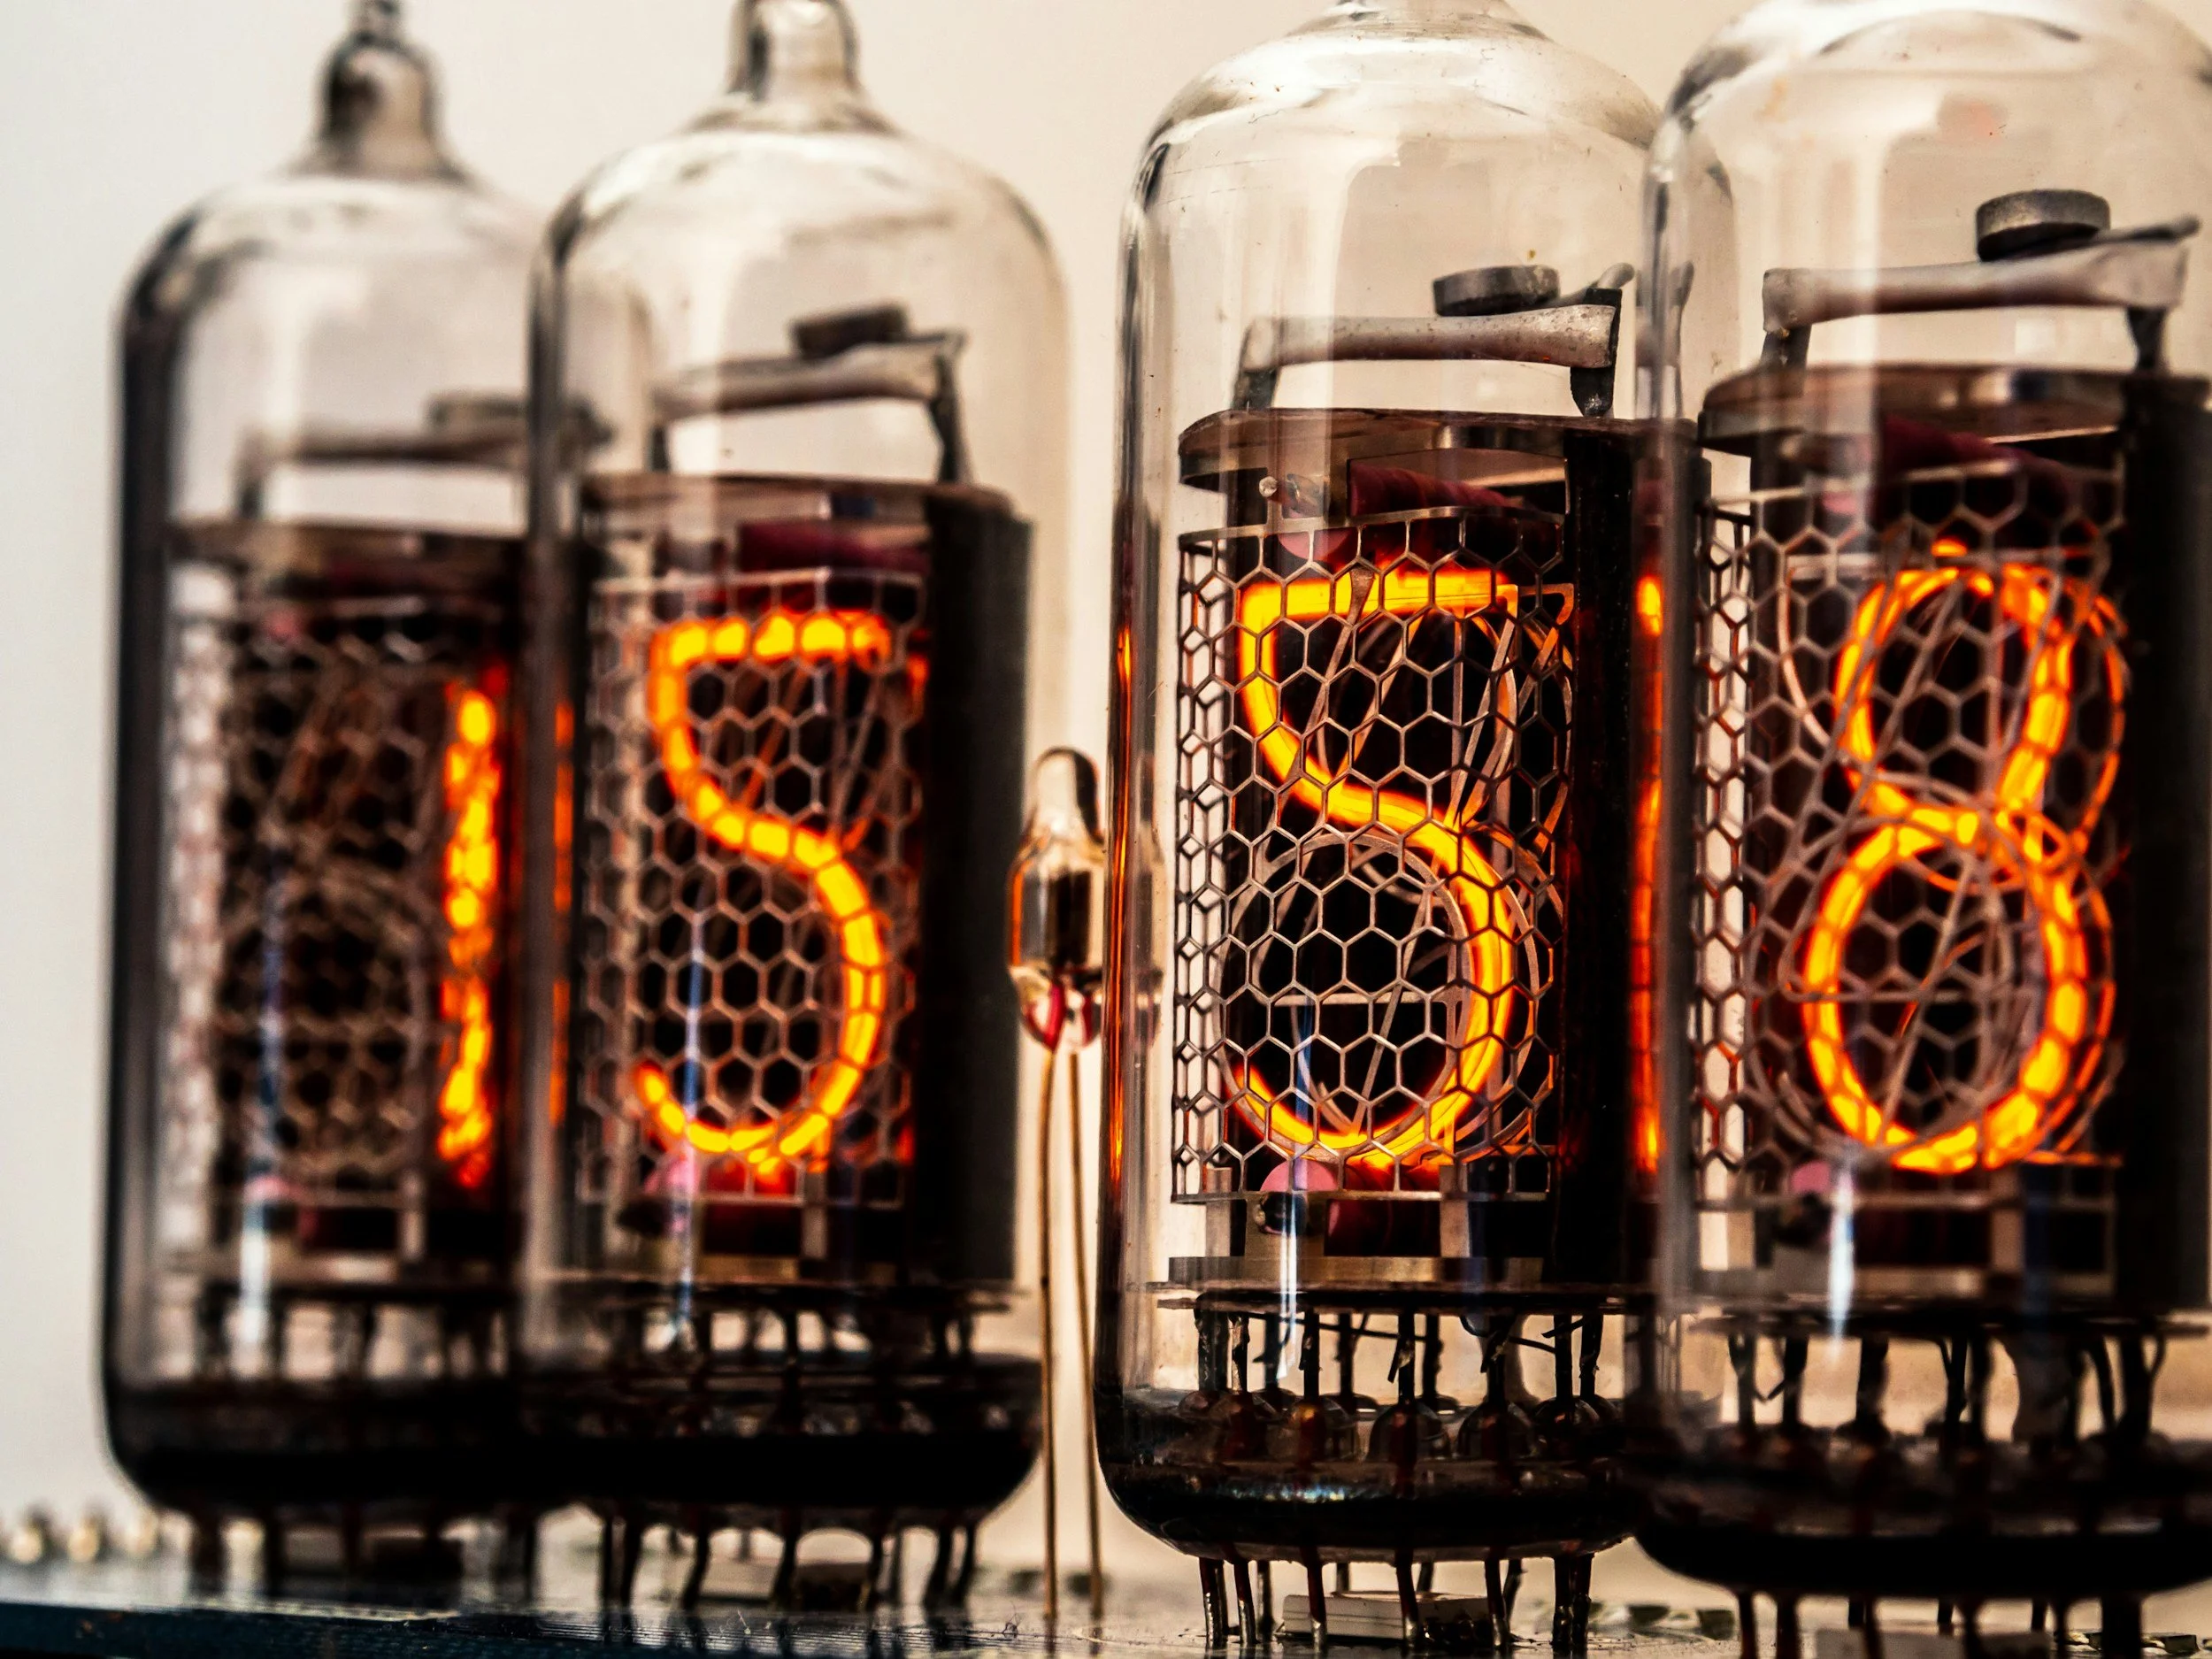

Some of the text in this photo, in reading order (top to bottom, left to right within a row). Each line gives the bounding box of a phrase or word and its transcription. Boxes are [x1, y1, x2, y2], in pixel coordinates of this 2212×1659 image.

[634, 612, 888, 1170] 5
[1229, 565, 1516, 1170] 5
[1801, 559, 2088, 1173] 8
